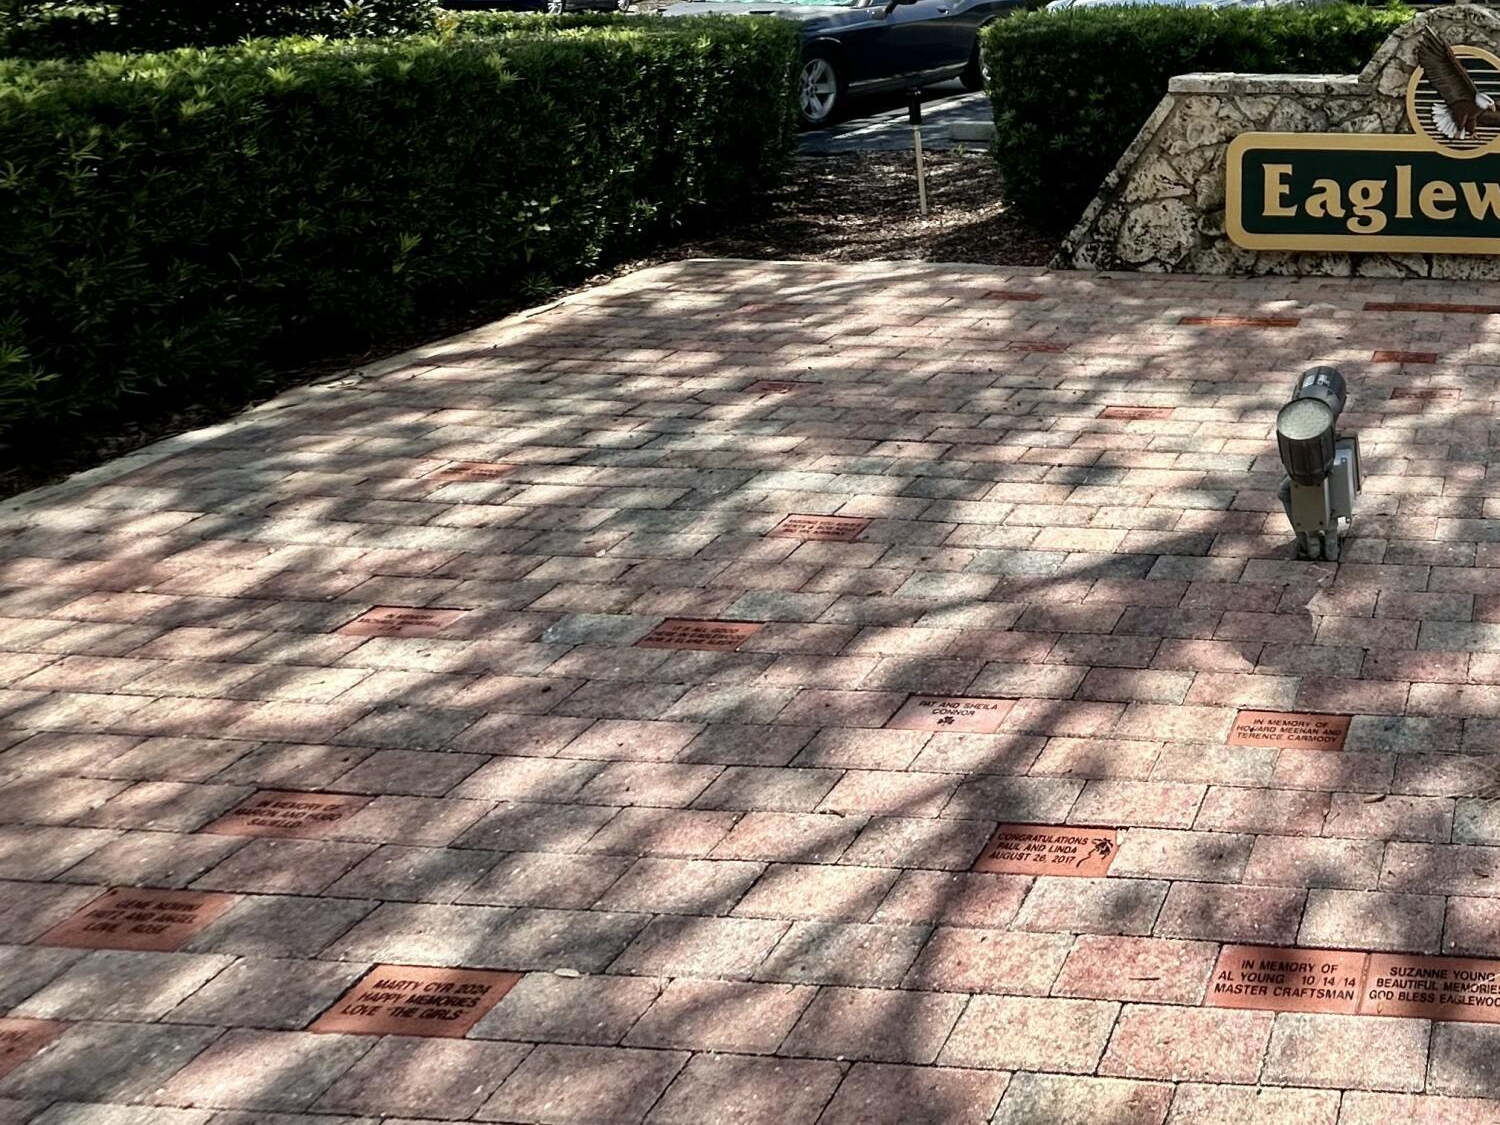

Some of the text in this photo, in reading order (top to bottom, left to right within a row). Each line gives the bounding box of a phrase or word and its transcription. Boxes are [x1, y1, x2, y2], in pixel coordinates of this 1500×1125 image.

[932, 708, 975, 716] CONNOR
[1268, 719, 1309, 727] MEMORY
[1236, 725, 1276, 733] HOWARD
[1280, 726, 1318, 734] MEENAN
[1236, 732, 1339, 743] TERENCE CARMODY
[271, 801, 322, 810] MEMORY
[281, 810, 306, 818] AND
[998, 833, 1088, 845] CONGRATULATIONS
[996, 842, 1077, 854] PAUL AND LINDA
[989, 852, 1028, 861] AUGUST
[1051, 855, 1076, 864] 2017
[124, 911, 154, 921] AND
[1241, 960, 1339, 974] IN MEMORY OF
[1218, 971, 1234, 981] AL
[1241, 972, 1285, 984] YOUNG
[1390, 967, 1496, 982] SUZANNE YOUNG
[372, 979, 424, 990] MARTY
[424, 982, 454, 993] CYR
[1376, 978, 1438, 990] BEAUTIFUL
[1214, 983, 1355, 1000] MASTER CRAFTSMAN
[1369, 990, 1394, 1000] GOD
[1398, 991, 1435, 1003] BLESS
[355, 992, 481, 1007] HAPPY MEMORIES
[341, 1004, 383, 1015] LOVE
